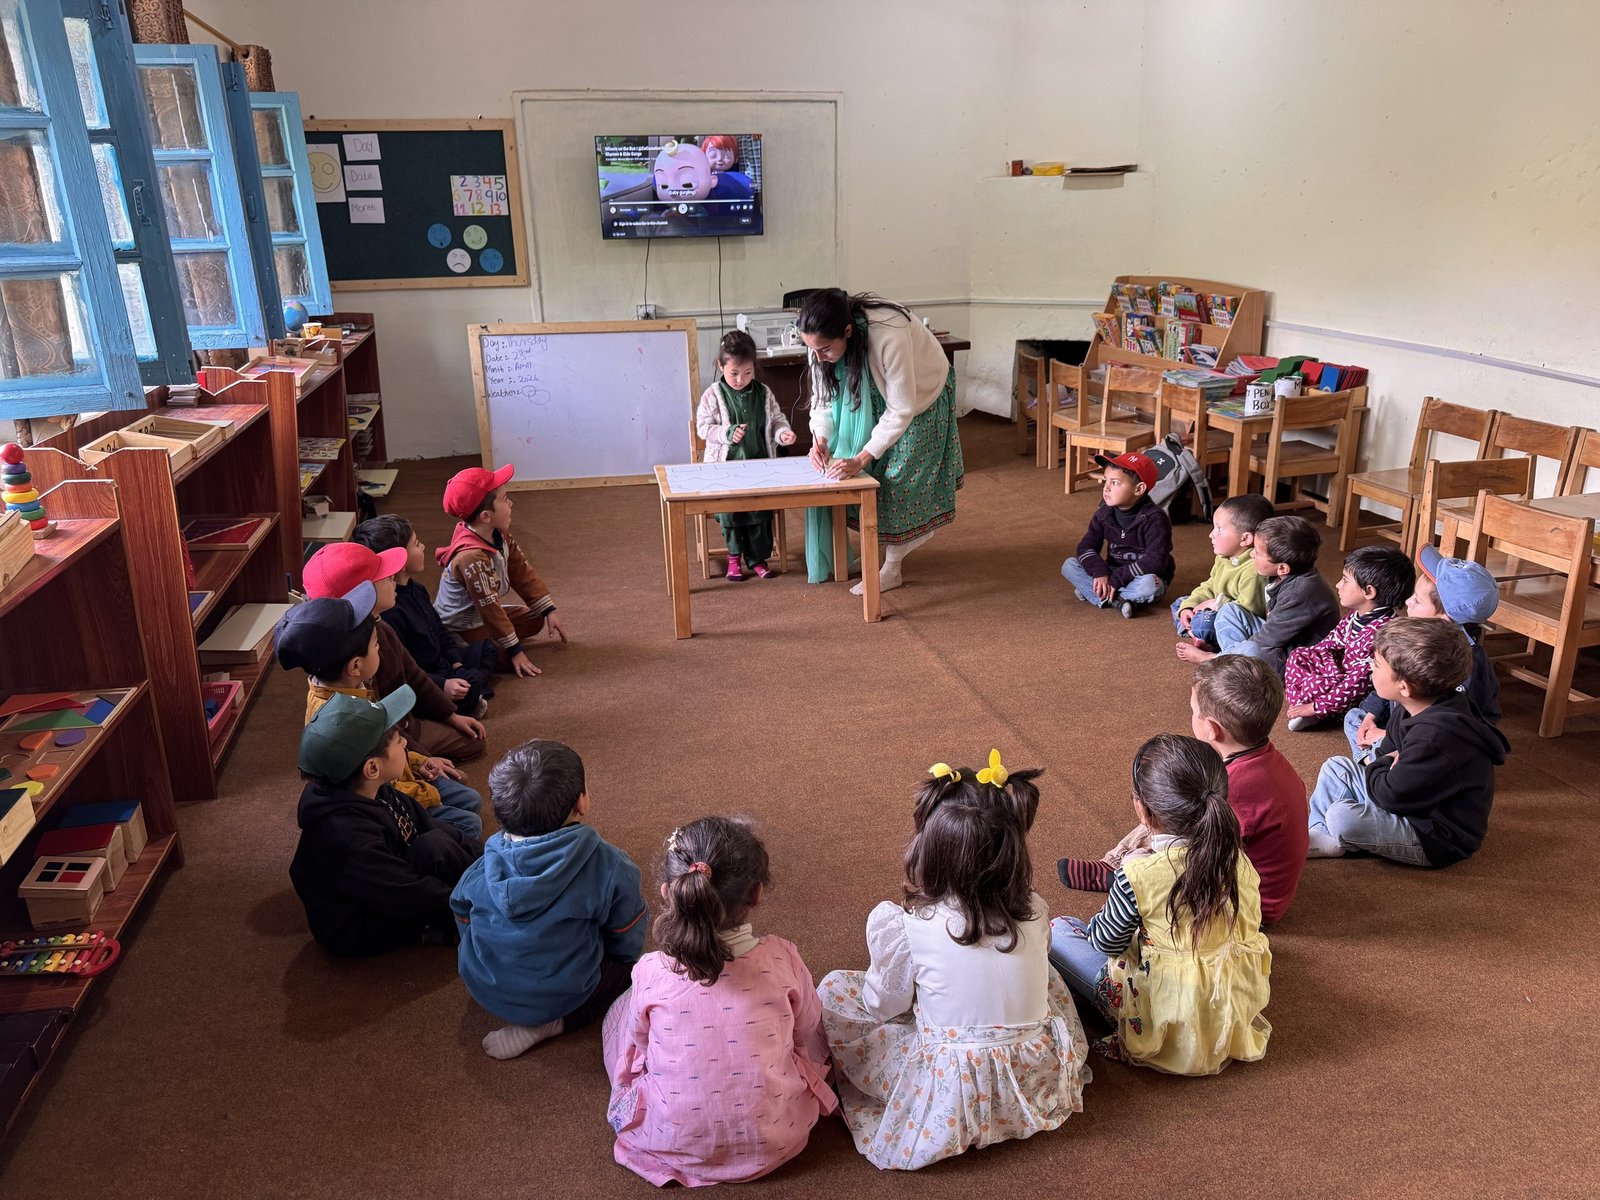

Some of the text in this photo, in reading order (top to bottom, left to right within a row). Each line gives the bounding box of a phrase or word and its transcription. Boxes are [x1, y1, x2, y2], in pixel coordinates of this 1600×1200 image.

[353, 138, 373, 153] Day
[350, 169, 374, 182] Date
[459, 175, 468, 187] 2
[473, 176, 481, 188] 3
[482, 175, 492, 189] 4
[494, 176, 504, 191] 5
[463, 189, 473, 202] 7
[475, 189, 483, 201] 8
[485, 189, 494, 204] 9
[496, 190, 507, 202] 10
[454, 201, 502, 216] 11 12 13
[482, 337, 500, 352] Day
[486, 354, 503, 364] Date
